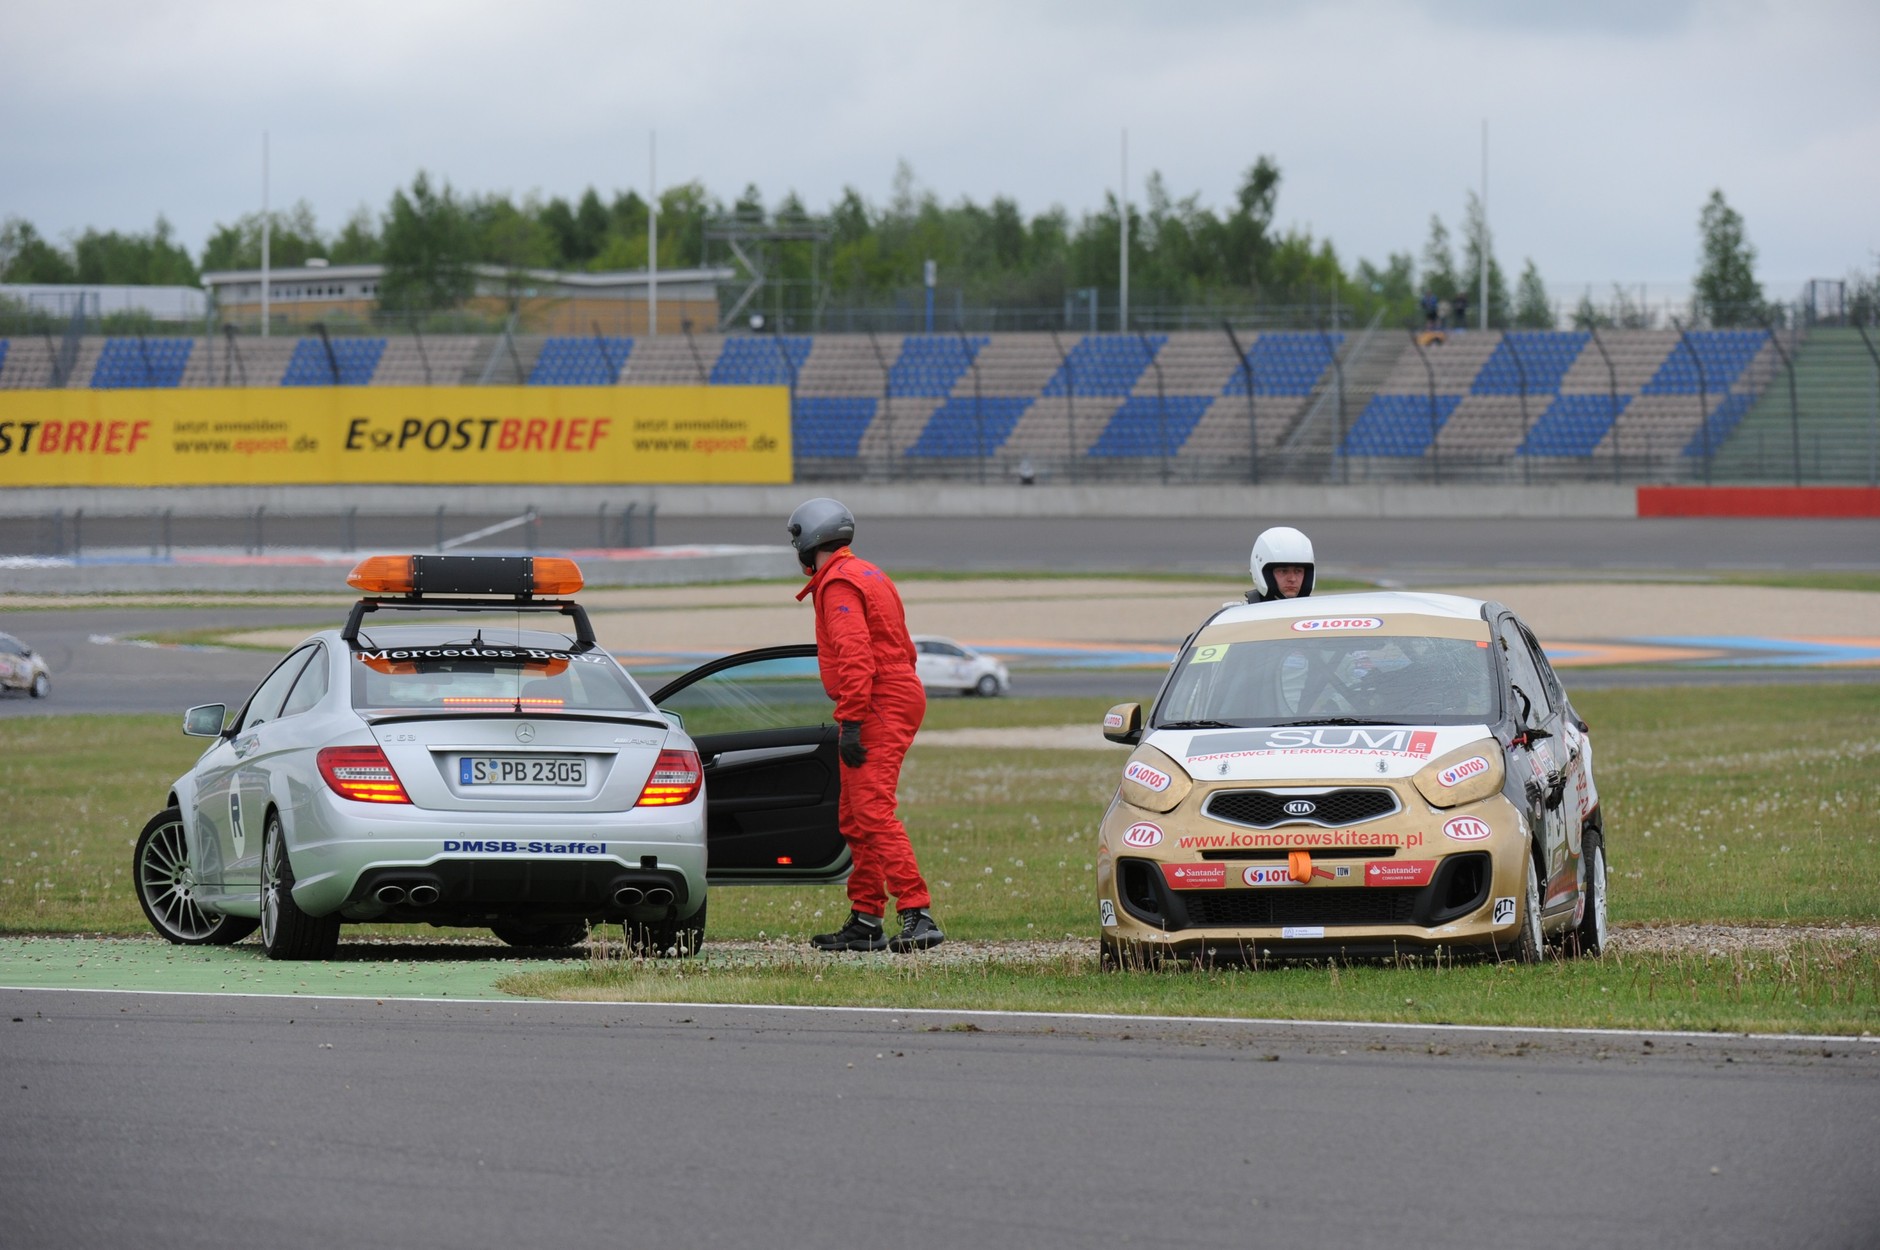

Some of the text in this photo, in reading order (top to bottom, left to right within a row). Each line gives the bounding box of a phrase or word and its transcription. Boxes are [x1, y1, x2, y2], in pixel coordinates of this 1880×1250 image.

[1322, 618, 1372, 629] LOTOS
[360, 648, 607, 665] Mercedes-Benz
[1198, 647, 1217, 661] 9
[1187, 748, 1429, 764] POKROWCE TERMOIZOLACYJNE
[474, 761, 486, 780] S
[532, 762, 582, 782] 2305
[1455, 758, 1485, 778] LOTOS
[1135, 767, 1166, 788] LOTOS
[1289, 803, 1310, 812] KIA
[230, 793, 243, 838] R
[1129, 828, 1155, 844] KIA
[1452, 824, 1485, 836] KIA
[1180, 830, 1423, 849] www.komorowskiteam.pl
[443, 840, 607, 855] DMSB-Staffel
[1186, 867, 1225, 877] Santander
[1336, 867, 1349, 876] TOW
[1381, 865, 1421, 875] Santander
